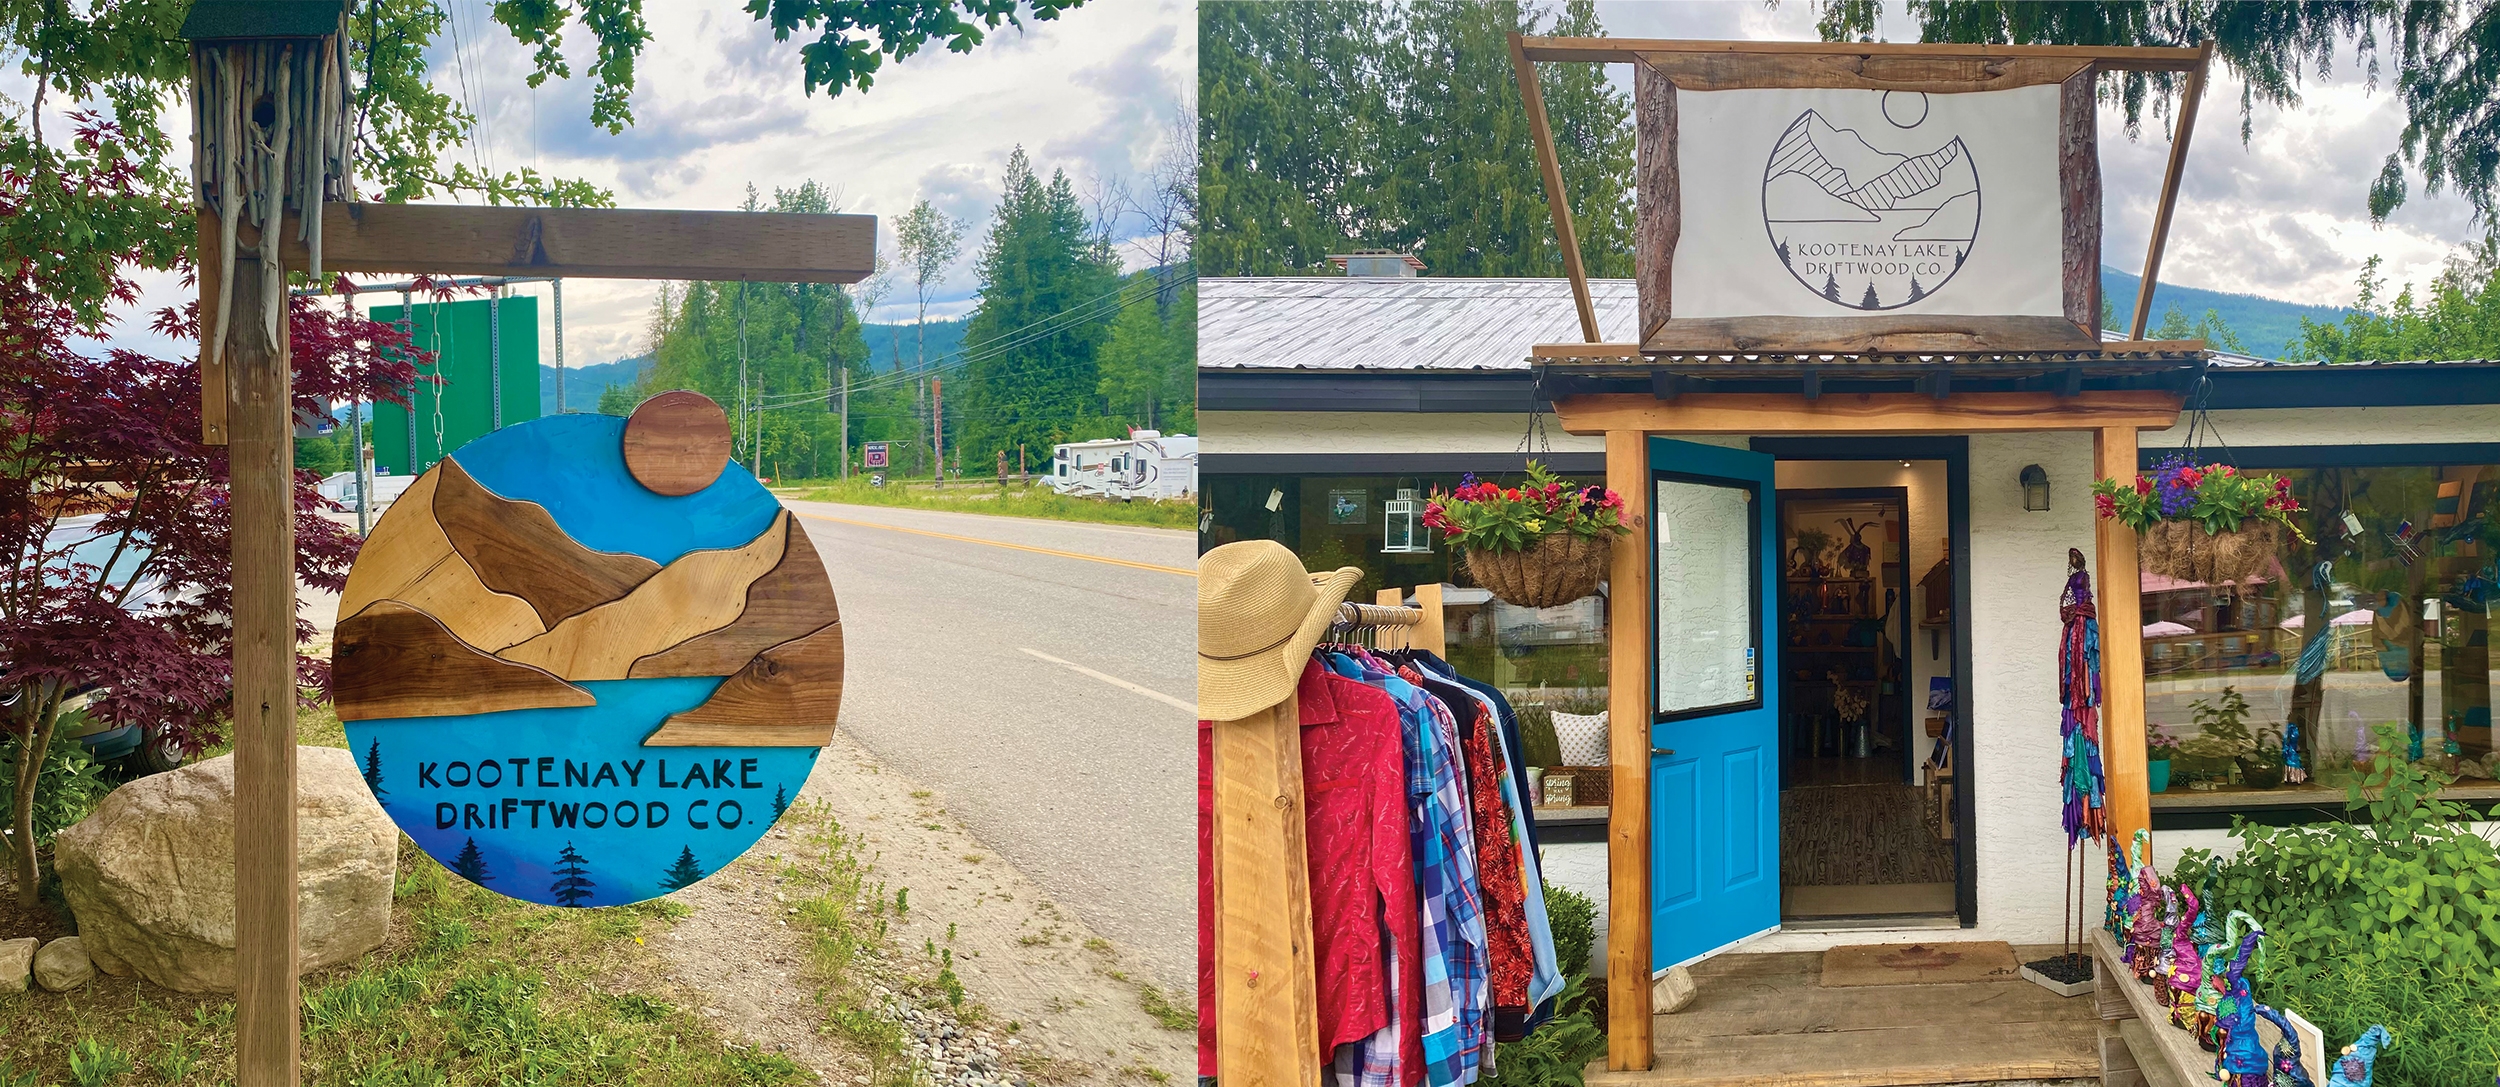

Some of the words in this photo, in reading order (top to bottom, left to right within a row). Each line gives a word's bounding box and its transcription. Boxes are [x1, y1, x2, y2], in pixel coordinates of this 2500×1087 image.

[1798, 243, 1898, 257] KOOTENAY
[1903, 244, 1950, 257] LAKE
[1805, 262, 1910, 275] DRIFTWOOD
[1915, 262, 1946, 276] CO.
[418, 757, 646, 789] KOOTENAY
[658, 757, 764, 790] LAKE
[434, 798, 669, 830] DRIFTWOOD
[687, 799, 754, 830] CO.
